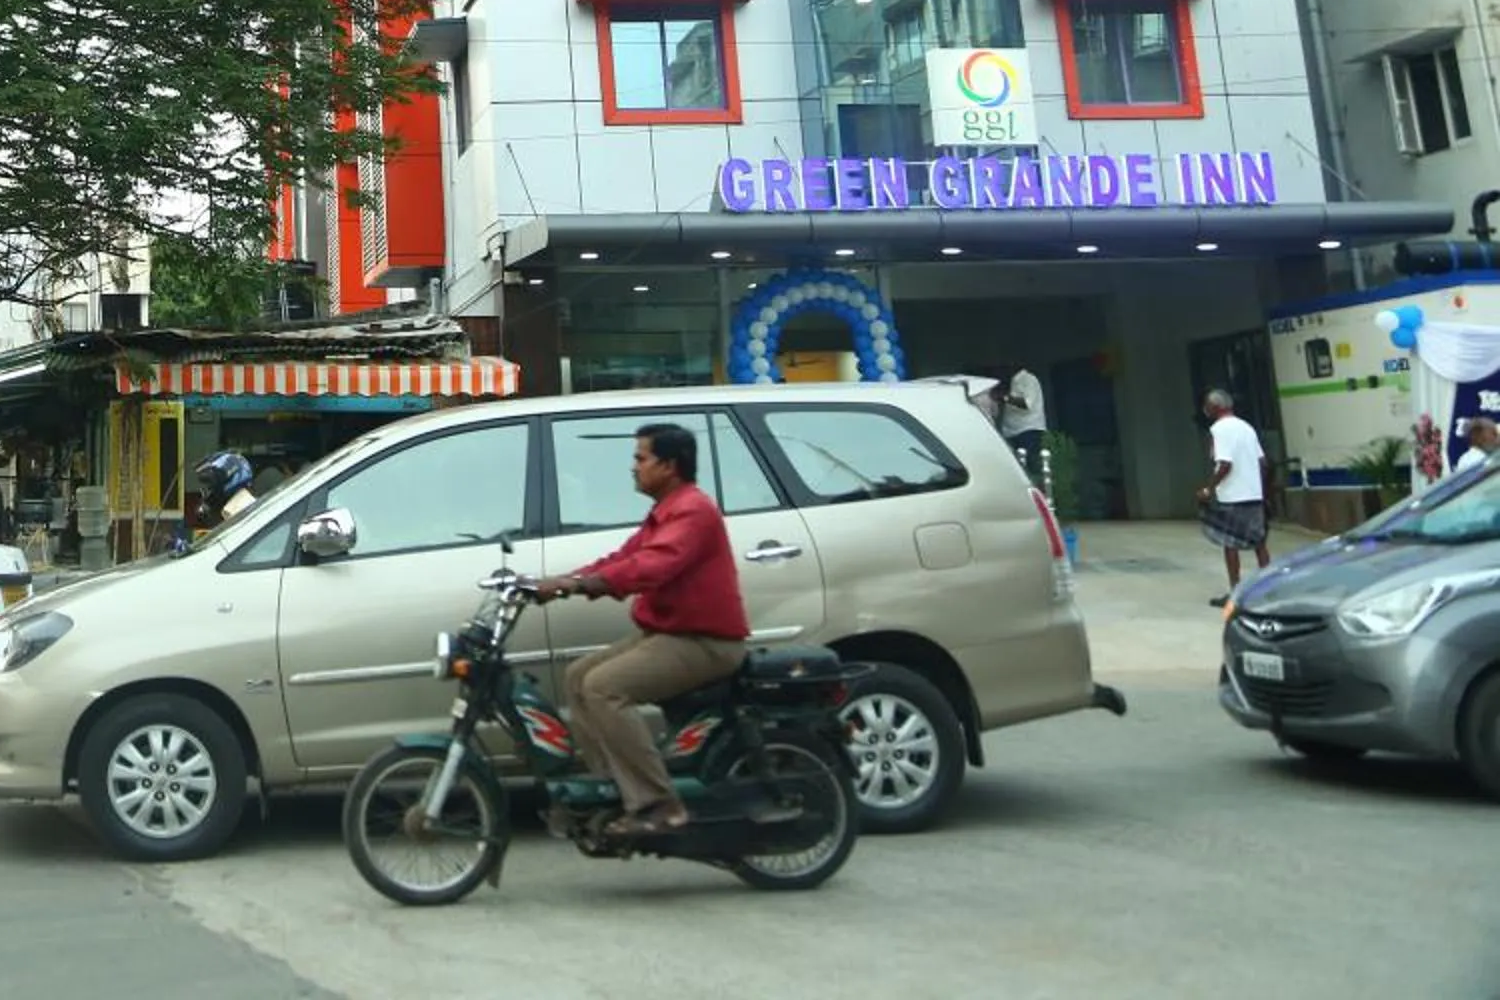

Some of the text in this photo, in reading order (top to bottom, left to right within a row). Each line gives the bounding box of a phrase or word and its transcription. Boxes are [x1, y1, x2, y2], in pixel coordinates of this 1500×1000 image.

[719, 151, 1277, 213] GREEN GRANDE INN
